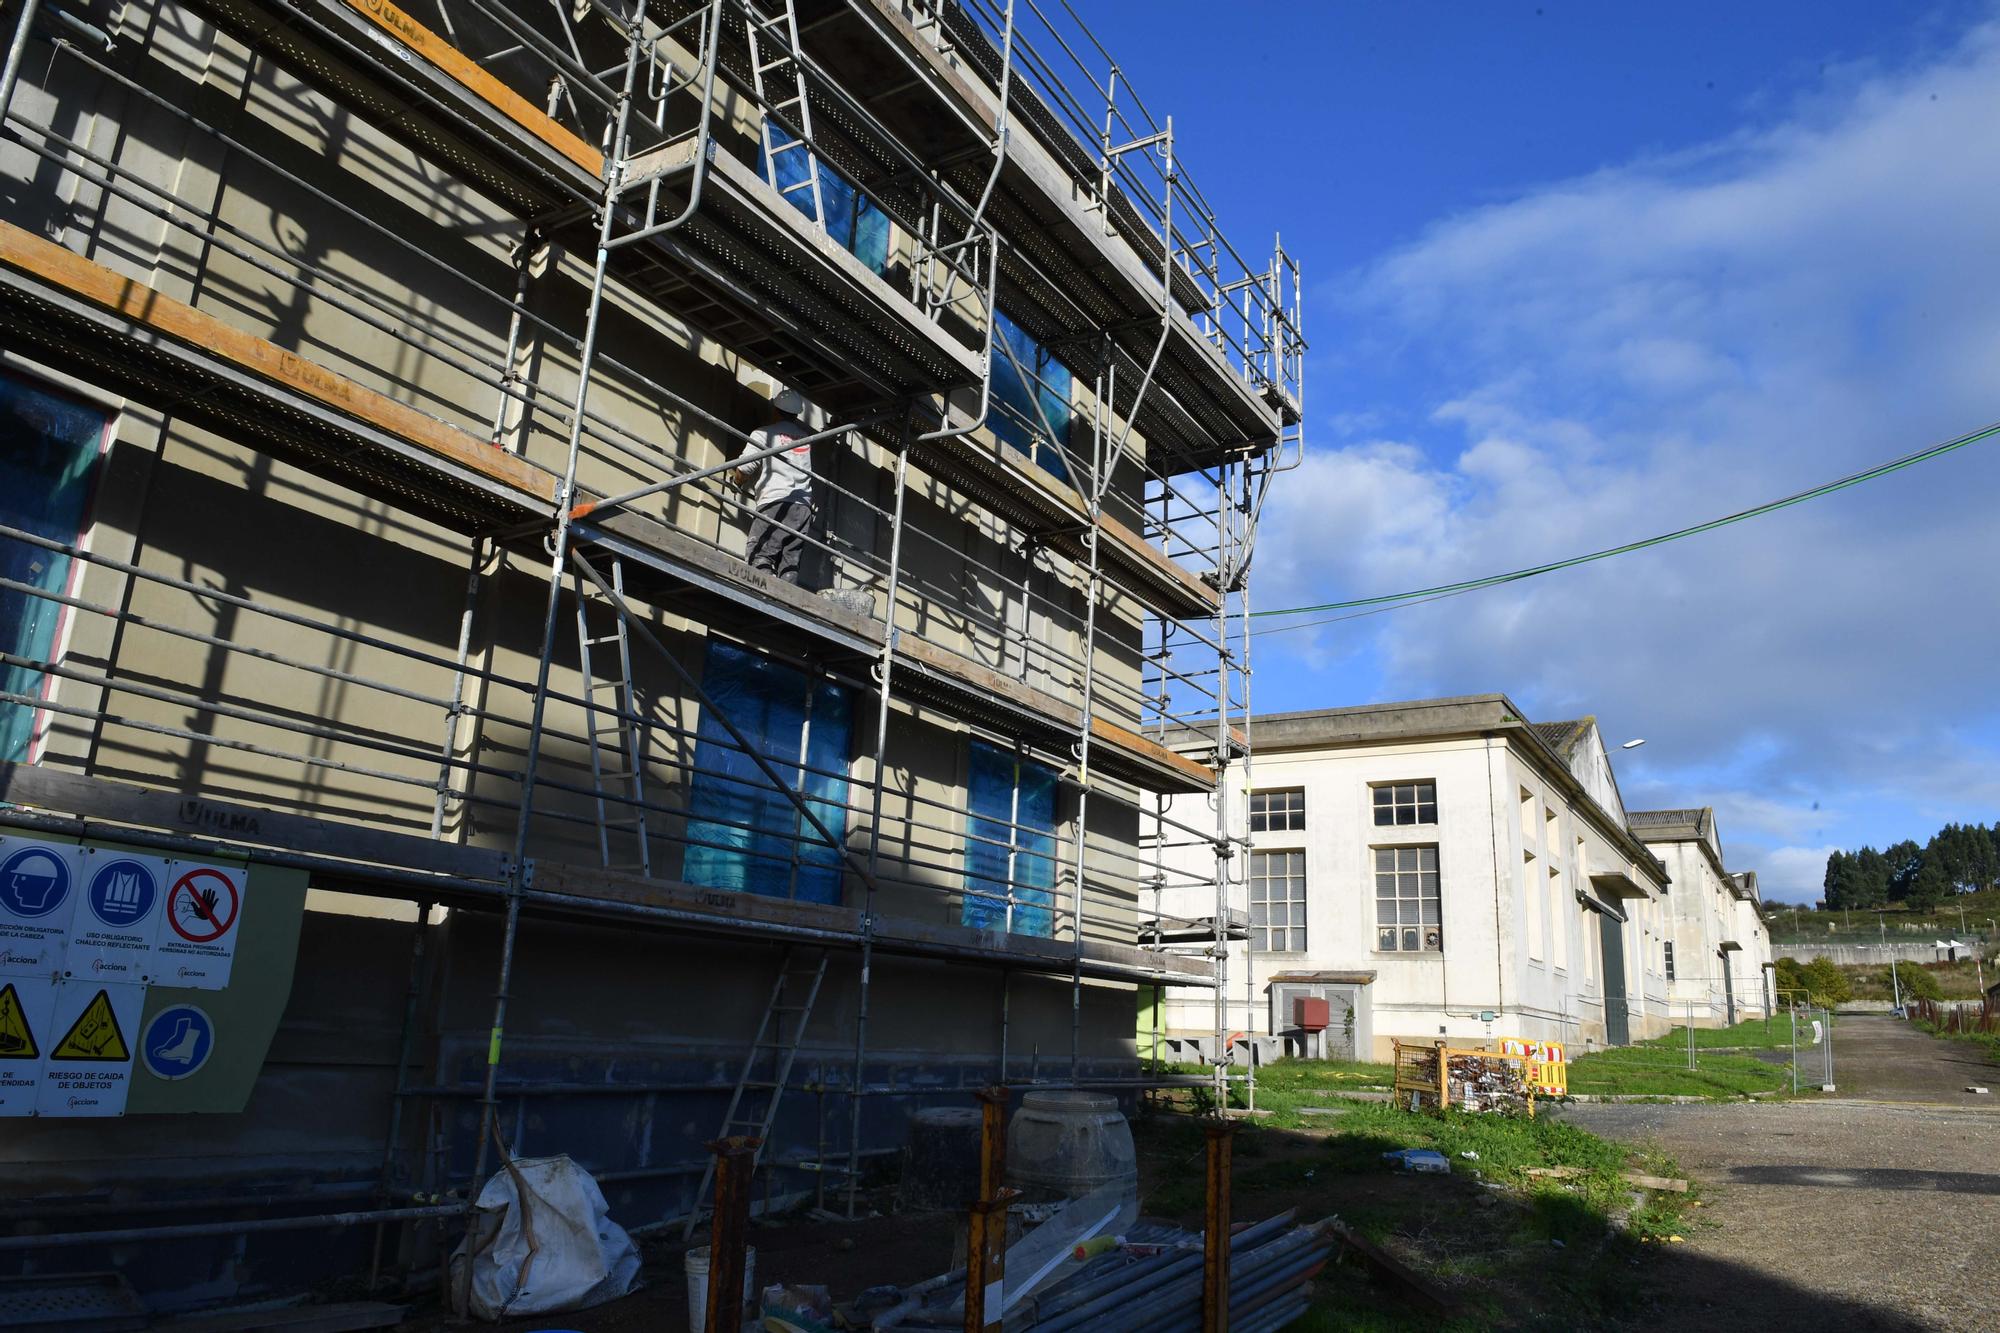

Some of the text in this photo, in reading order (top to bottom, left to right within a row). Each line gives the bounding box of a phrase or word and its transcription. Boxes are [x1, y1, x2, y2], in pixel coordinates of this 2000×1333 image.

[384, 7, 425, 46] ULMA
[740, 567, 768, 590] ULMA
[24, 926, 64, 935] OBLIGATORIA
[101, 933, 143, 943] OBLIGATORIO
[75, 939, 151, 951] CHALECO REFLECTANTE
[196, 950, 231, 958] AUTORIZADAS
[7, 955, 38, 965] acciona
[99, 963, 127, 971] acciona
[48, 1072, 125, 1081] RIESGO DE CAIDA
[0, 1079, 35, 1087] ENDIDAS
[58, 1081, 113, 1089] DE OBJETOS
[73, 1098, 99, 1106] acciona
